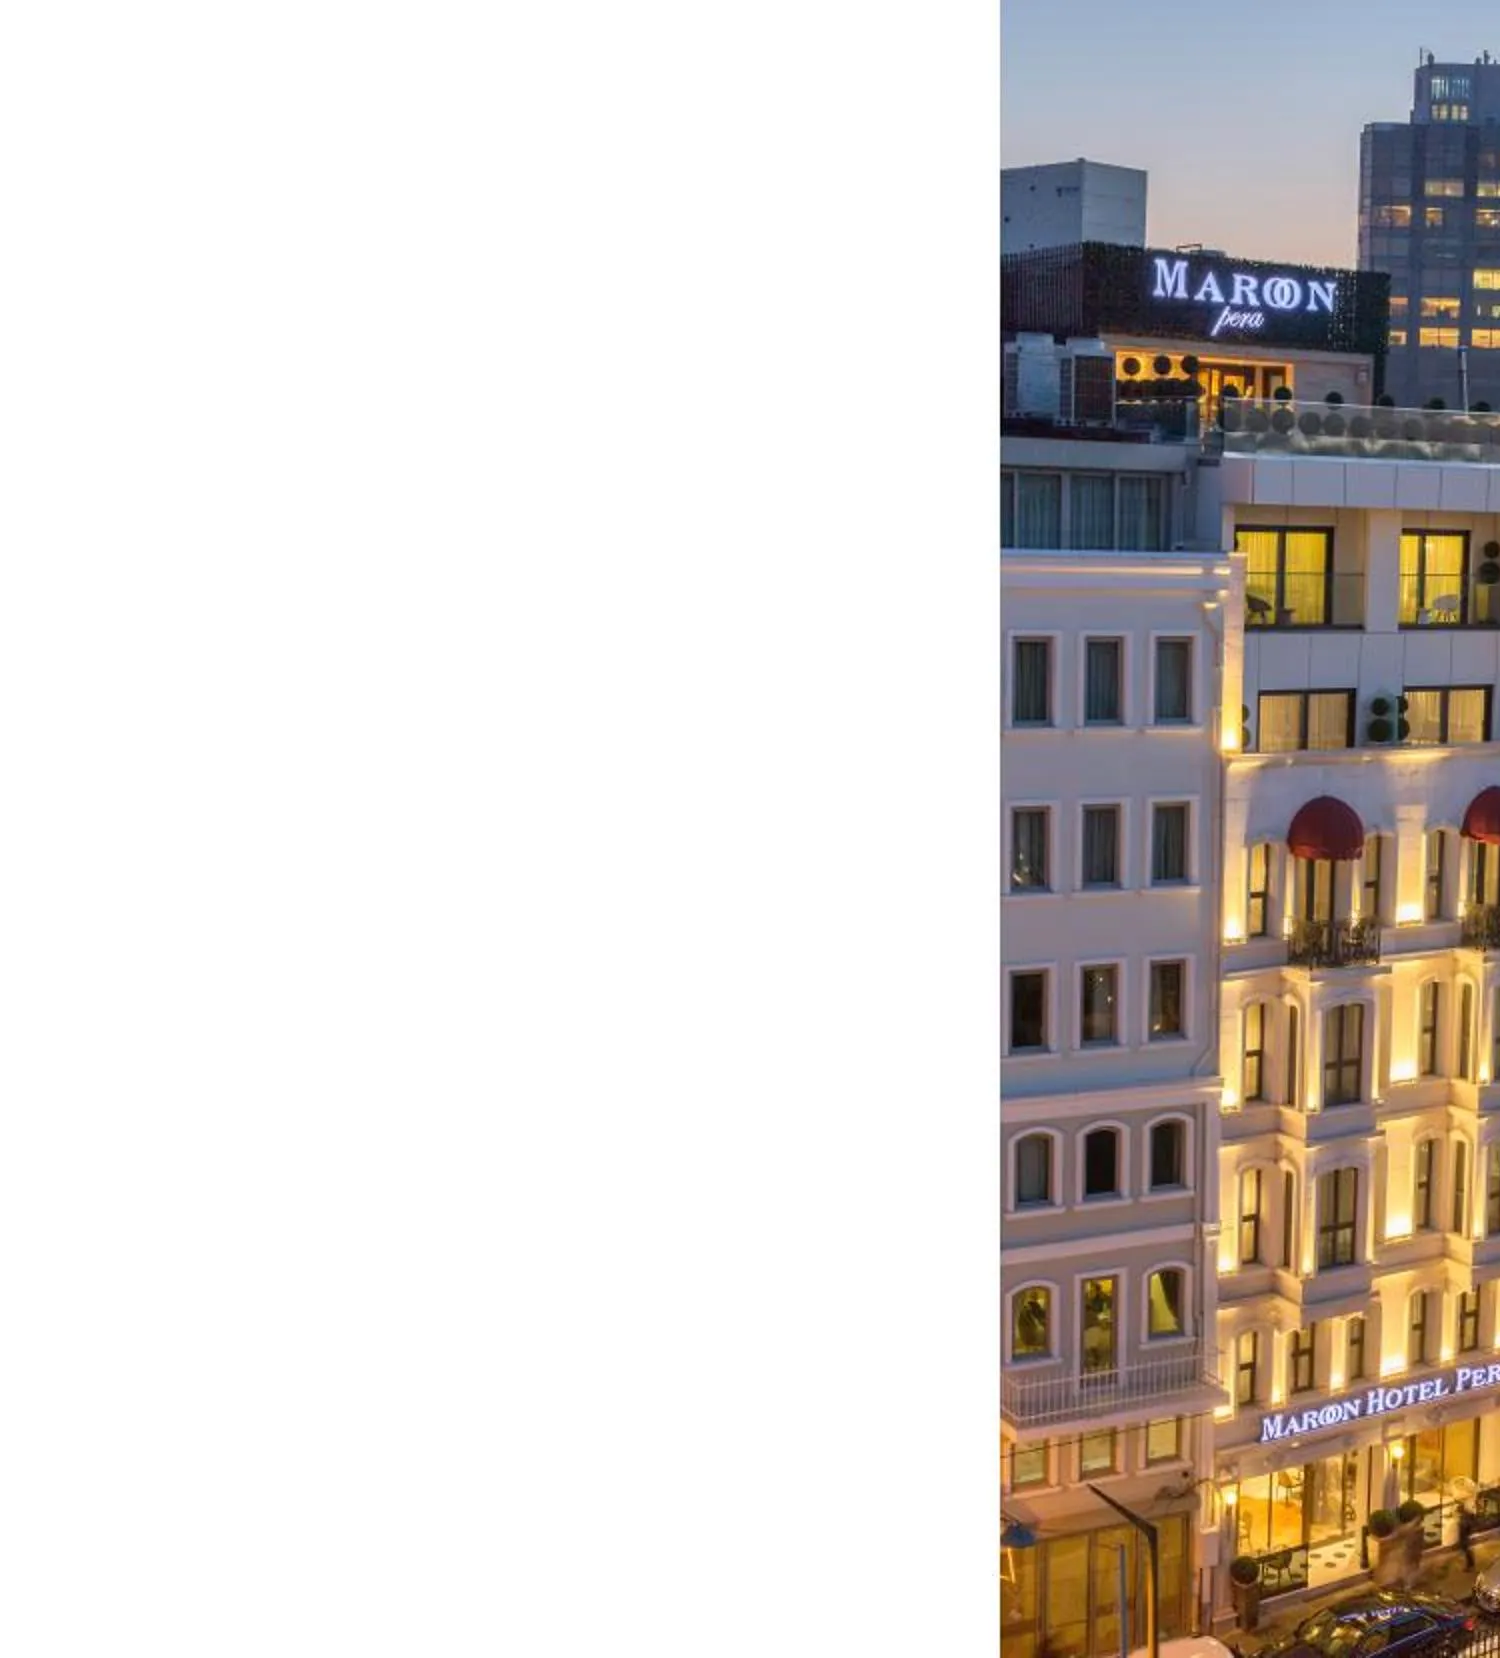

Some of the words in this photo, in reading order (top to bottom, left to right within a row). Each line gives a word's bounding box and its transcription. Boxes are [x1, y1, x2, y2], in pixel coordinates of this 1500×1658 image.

[1152, 258, 1337, 312] MAROON
[1211, 306, 1265, 337] pera
[1260, 1403, 1360, 1441] MAROON
[1367, 1379, 1450, 1414] HOTEL
